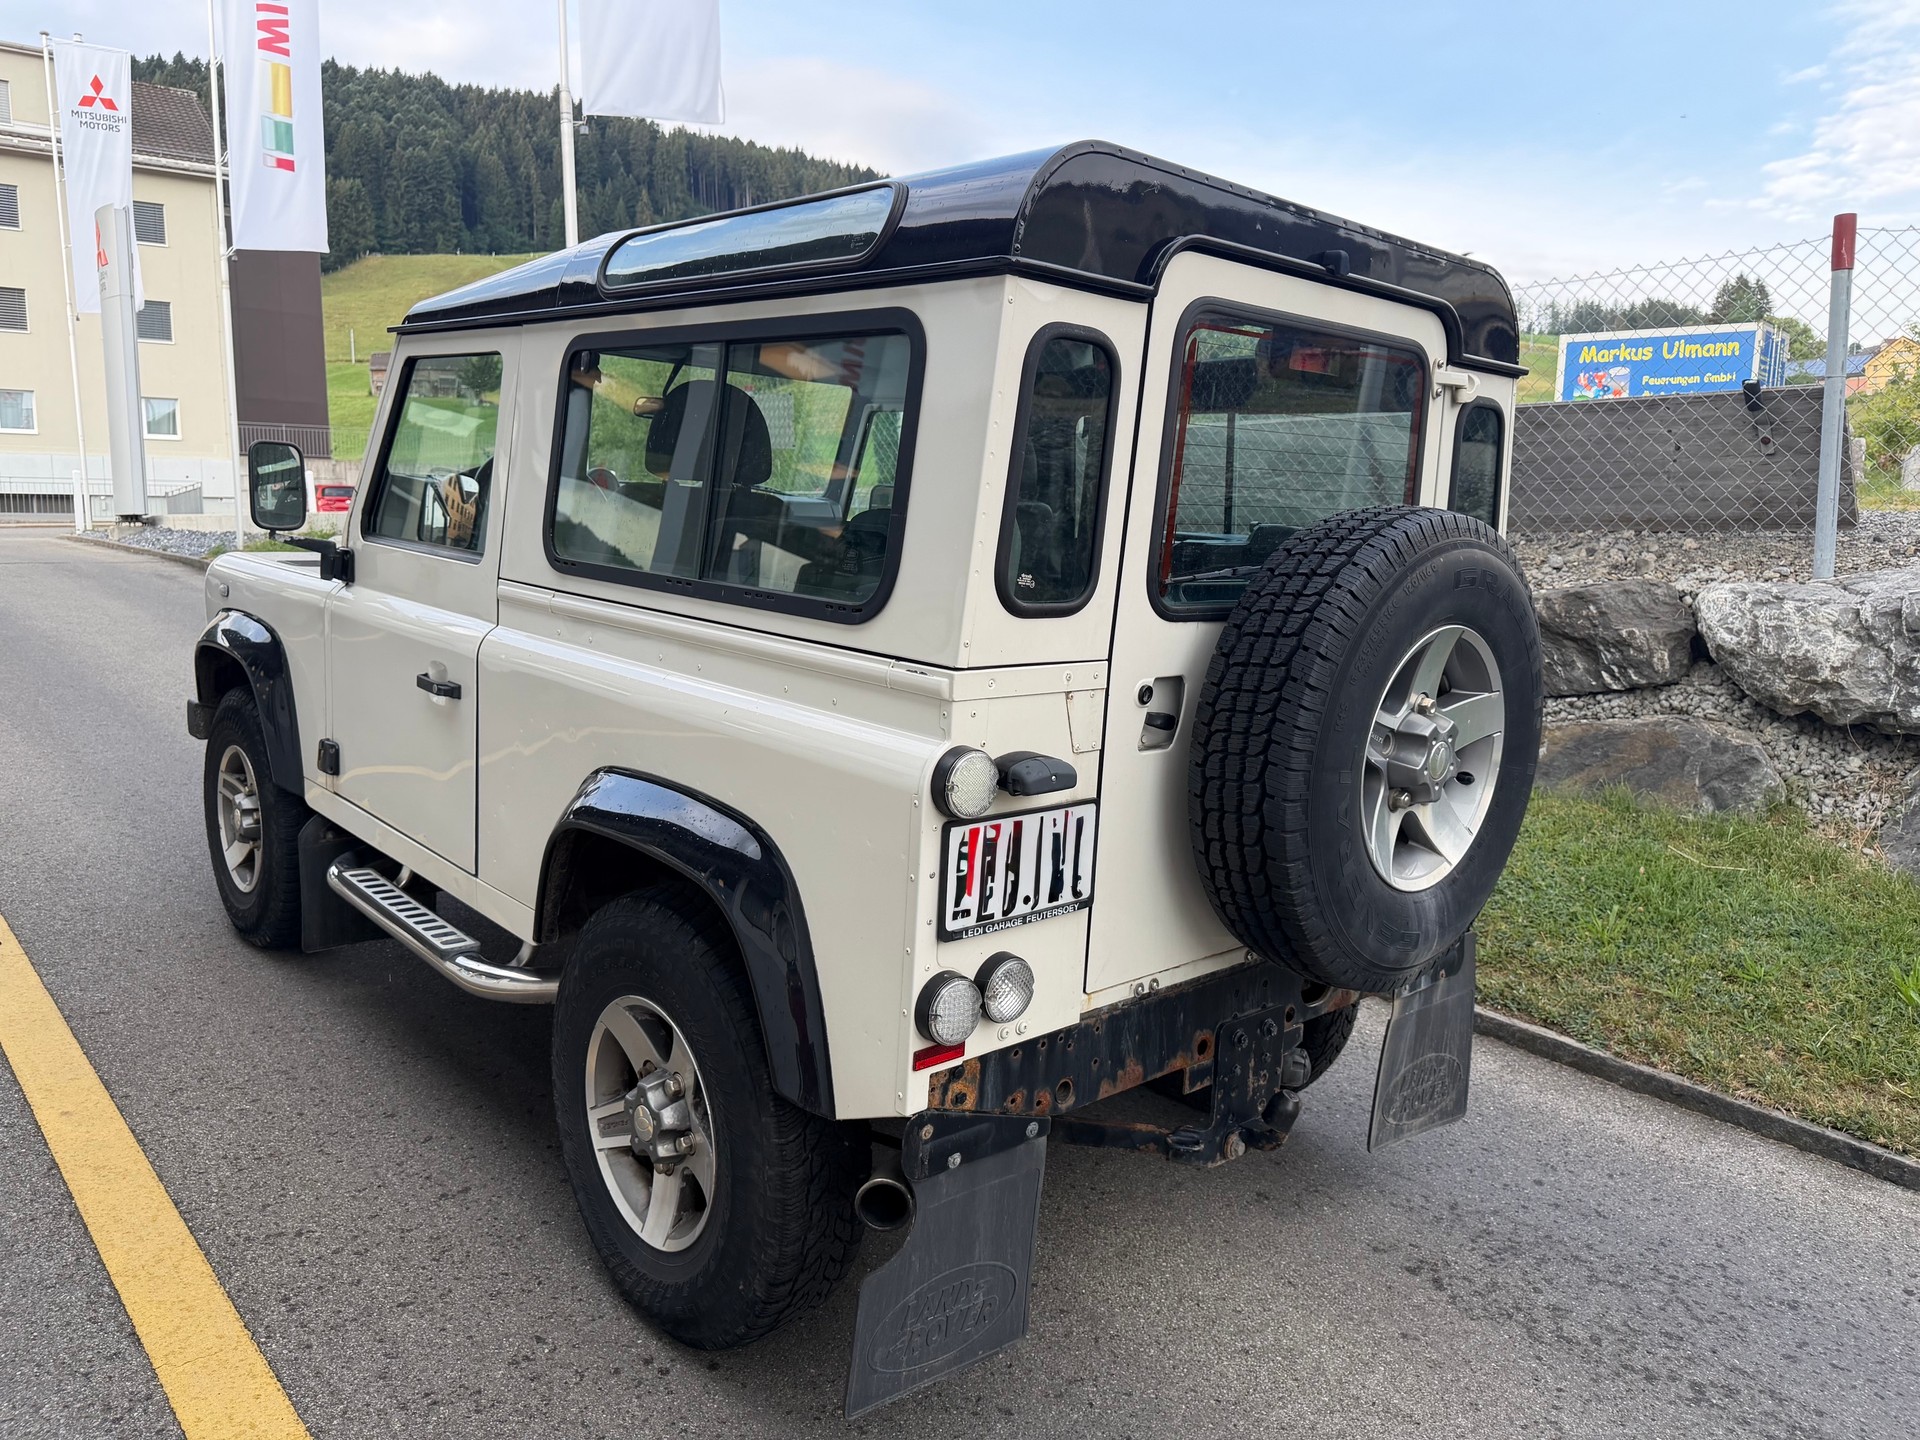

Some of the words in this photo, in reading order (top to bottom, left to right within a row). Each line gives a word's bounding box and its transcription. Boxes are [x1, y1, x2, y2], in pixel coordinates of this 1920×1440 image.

[71, 109, 127, 124] MITSUBISHI
[80, 120, 121, 133] MOTORS
[1578, 342, 1653, 364] Markus
[1662, 339, 1740, 360] Ulmann
[962, 928, 984, 938] LEDI
[985, 917, 1023, 933] GARAGE
[1026, 903, 1080, 923] FEUTERSOEY
